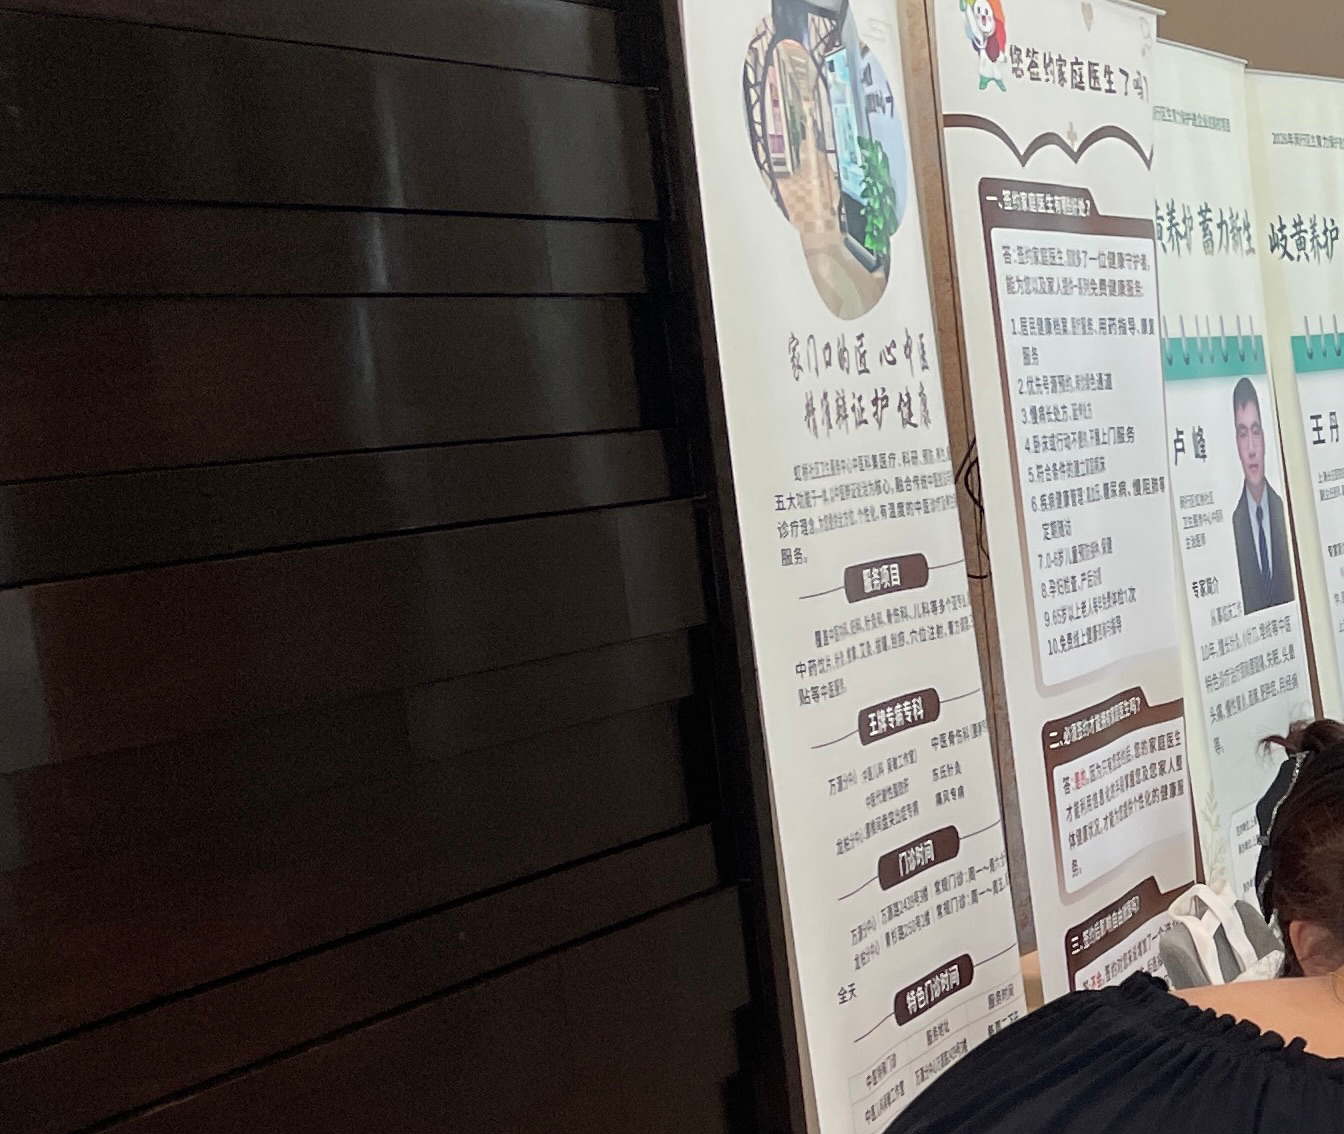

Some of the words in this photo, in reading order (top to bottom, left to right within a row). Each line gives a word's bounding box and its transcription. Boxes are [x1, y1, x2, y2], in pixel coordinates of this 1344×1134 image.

[1269, 212, 1339, 264] 岐黄养护
[862, 563, 901, 593] 服务项目
[898, 839, 935, 877] 门诊时间
[836, 982, 857, 1007] 全天
